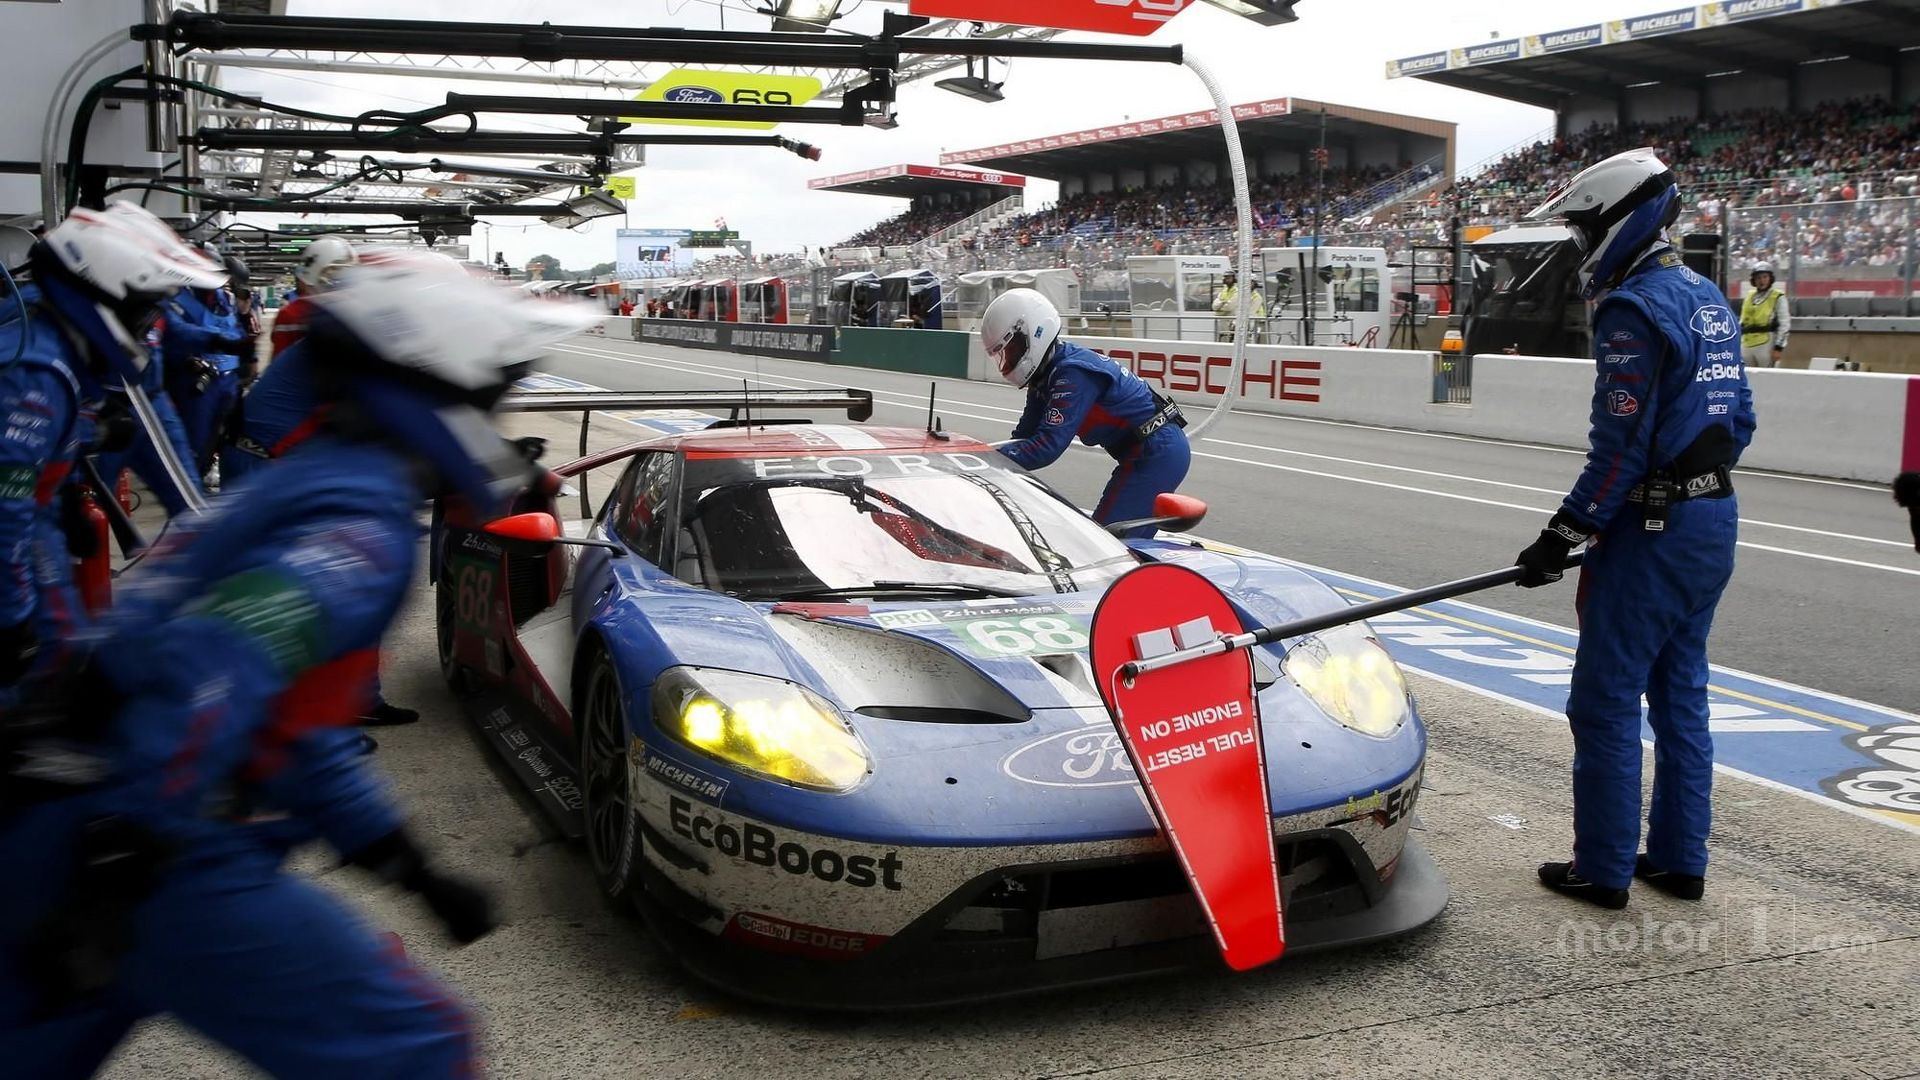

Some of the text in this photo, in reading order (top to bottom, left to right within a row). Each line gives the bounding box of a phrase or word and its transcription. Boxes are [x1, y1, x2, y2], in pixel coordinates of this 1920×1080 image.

[1631, 11, 1695, 32] MICHELIN
[1544, 28, 1600, 47] MICHELIN
[1469, 42, 1519, 60] MICHELIN
[1402, 54, 1446, 70] MICHELIN
[732, 89, 792, 106] 69
[1233, 107, 1258, 117] TOTAL
[1260, 102, 1286, 113] TOTAL
[1162, 119, 1184, 129] TOTAL
[1186, 115, 1208, 125] TOTAL
[940, 169, 978, 180] Audi Sport
[1181, 261, 1222, 270] Porsche Team
[1331, 254, 1376, 263] Porsche Team
[1701, 310, 1731, 336] Ford
[754, 453, 990, 478] FORD
[457, 565, 493, 629] 68
[878, 610, 931, 627] PRO
[980, 608, 1002, 616] LE
[1004, 606, 1054, 615] MANS
[966, 617, 1090, 655] 68
[1140, 701, 1243, 742] ENGINE ON
[1062, 732, 1134, 779] Fo
[1147, 728, 1255, 772] FUEL RESET
[648, 756, 723, 799] MICHELIN
[669, 794, 904, 892] EcoBoost
[751, 919, 866, 952] Castrol EDGE
